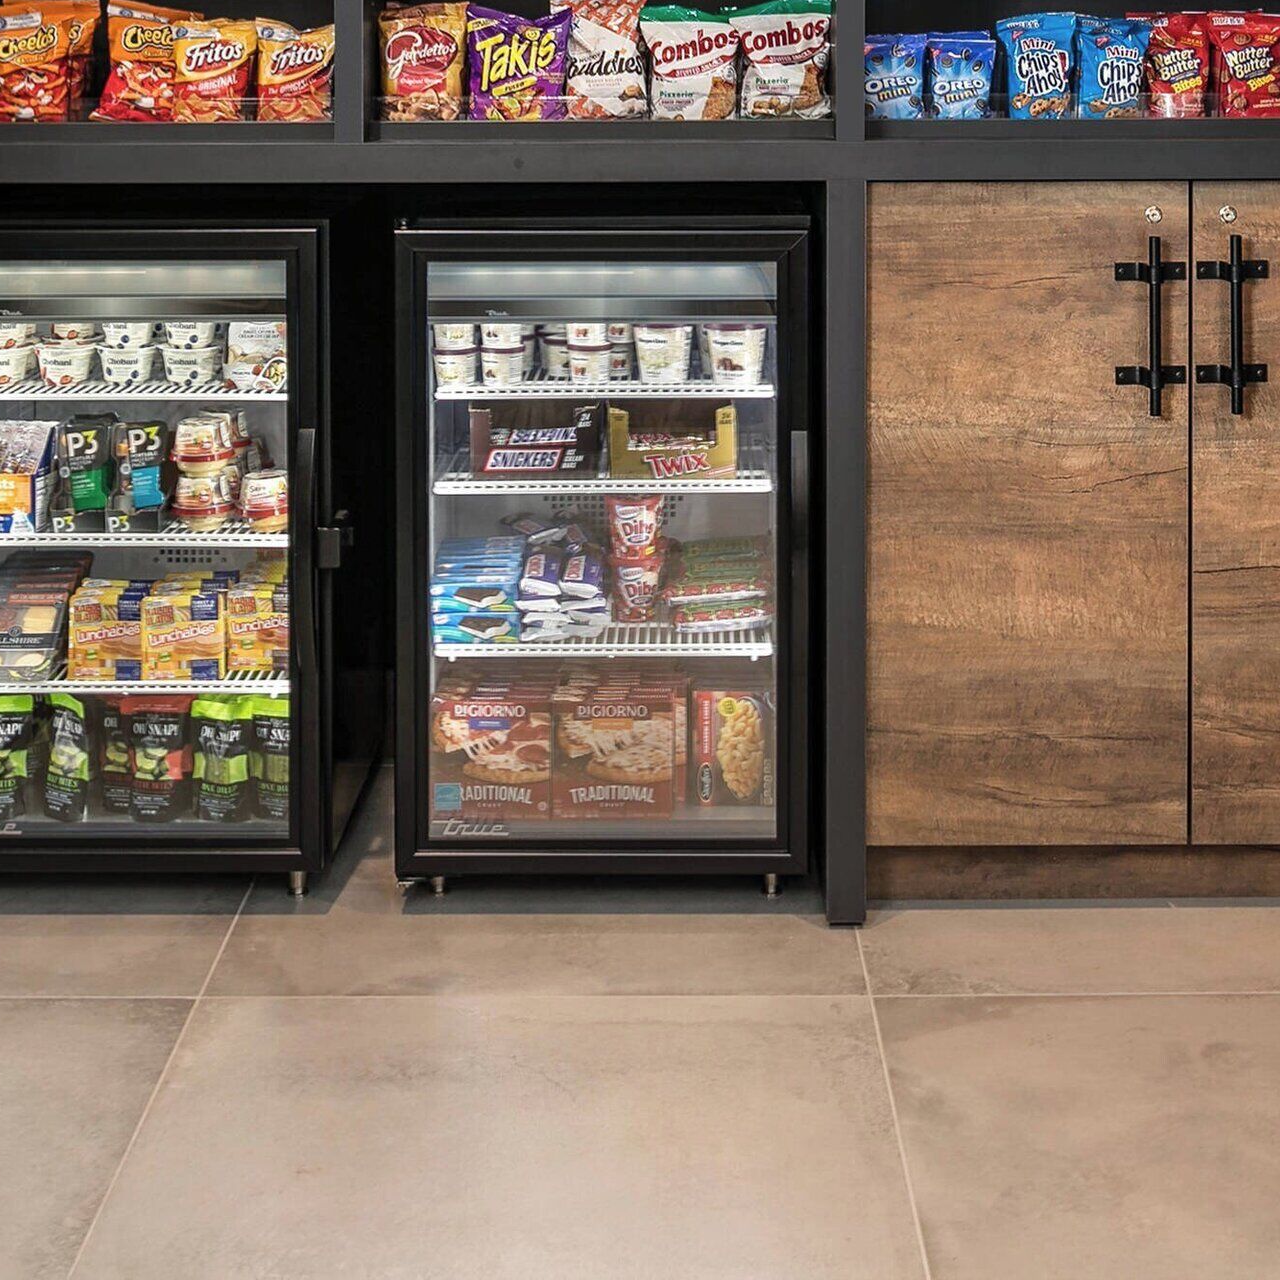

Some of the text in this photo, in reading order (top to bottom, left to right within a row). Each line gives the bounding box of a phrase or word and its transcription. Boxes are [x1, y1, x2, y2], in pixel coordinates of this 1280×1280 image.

[741, 19, 828, 55] Combos
[1021, 38, 1054, 51] Mini
[185, 41, 243, 71] Fritos
[386, 31, 457, 80] Gardetto's
[650, 29, 740, 65] Combos
[1106, 46, 1139, 60] Mini
[271, 42, 324, 75] Fritos
[475, 31, 556, 93] Takis
[567, 50, 643, 80] Buddies
[1018, 52, 1059, 78] Chips
[1153, 49, 1195, 70] Nutter
[1099, 60, 1143, 87] Chips
[1160, 58, 1201, 81] Butter
[1233, 56, 1275, 80] Butter
[197, 75, 238, 93] ORIGINAL
[755, 76, 789, 86] Pizzeria
[864, 76, 917, 94] OREO
[932, 78, 985, 96] OREO
[1171, 76, 1203, 94] Bites
[659, 91, 694, 99] Pizzeria
[877, 86, 912, 103] mini
[944, 88, 978, 104] mini
[41, 356, 73, 367] Chobani
[106, 356, 139, 367] Chobani
[168, 356, 198, 367] Chobani
[66, 429, 98, 457] P3
[128, 426, 161, 454] P3
[490, 451, 558, 468] SNICKERS
[645, 455, 711, 480] TWIX
[52, 515, 75, 533] P3
[108, 515, 130, 533] P3
[621, 520, 655, 537] Dibs
[624, 581, 658, 598] Dibs
[76, 621, 141, 644] Lunchables
[147, 620, 216, 647] Lunchables
[454, 704, 527, 718] DIGIORNO
[132, 722, 147, 734] OH
[569, 784, 656, 804] TRADITIONAL
[431, 818, 511, 836] true
